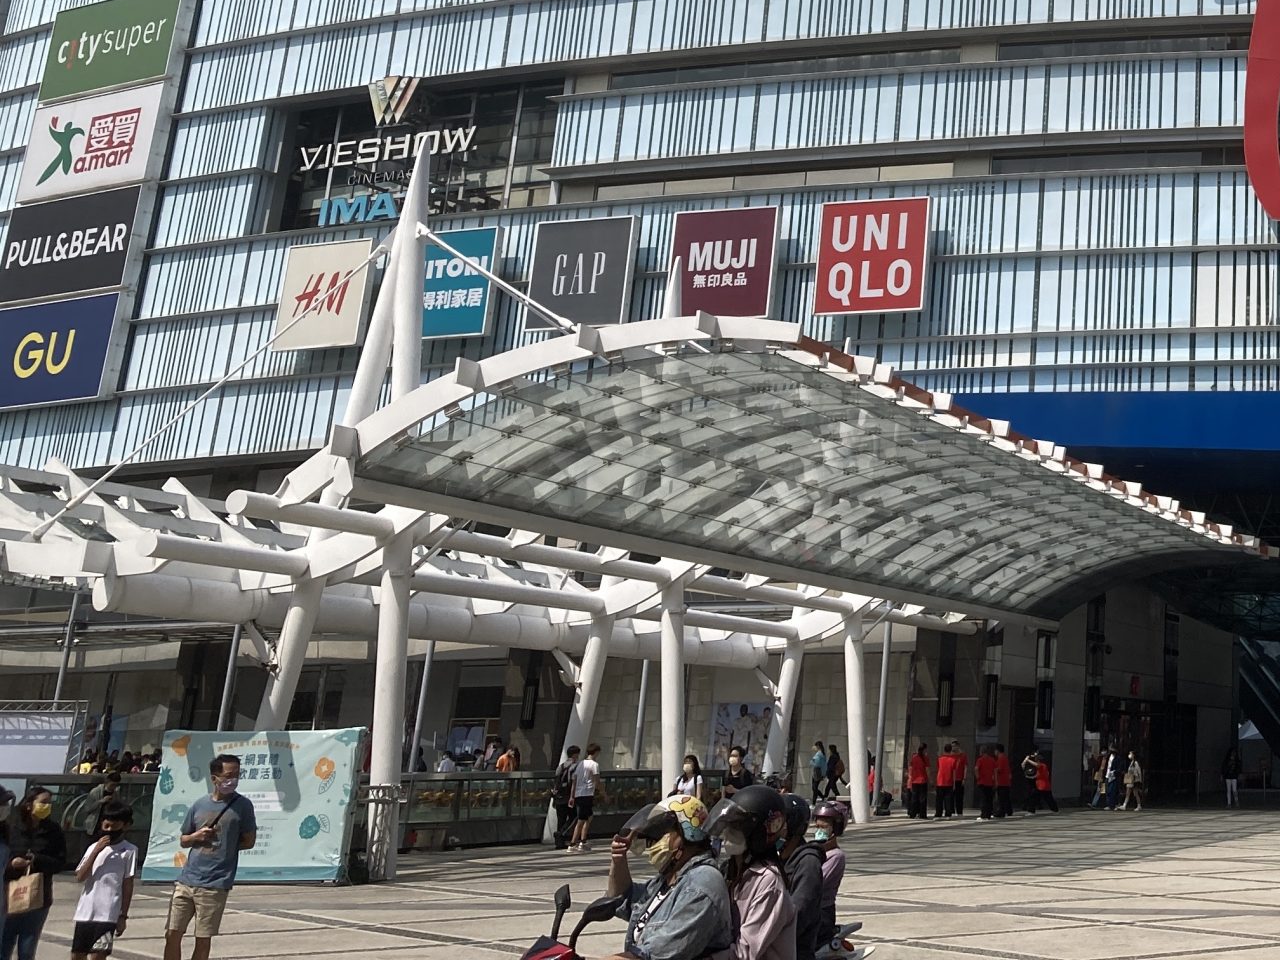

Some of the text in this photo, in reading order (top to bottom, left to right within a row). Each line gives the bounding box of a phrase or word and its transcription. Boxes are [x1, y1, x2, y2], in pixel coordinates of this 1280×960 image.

[87, 112, 139, 151] 愛買
[73, 145, 133, 174] a.mart
[318, 192, 400, 227] IMA
[5, 223, 127, 270] PULL&BEAR
[832, 212, 908, 253] UNI
[423, 255, 489, 280] ITORI
[552, 251, 606, 296] GAP
[688, 238, 757, 272] MUJI
[422, 287, 484, 310] 得利家居
[692, 272, 748, 288] 無印良品
[828, 259, 912, 306] QLO
[13, 329, 76, 379] GU
